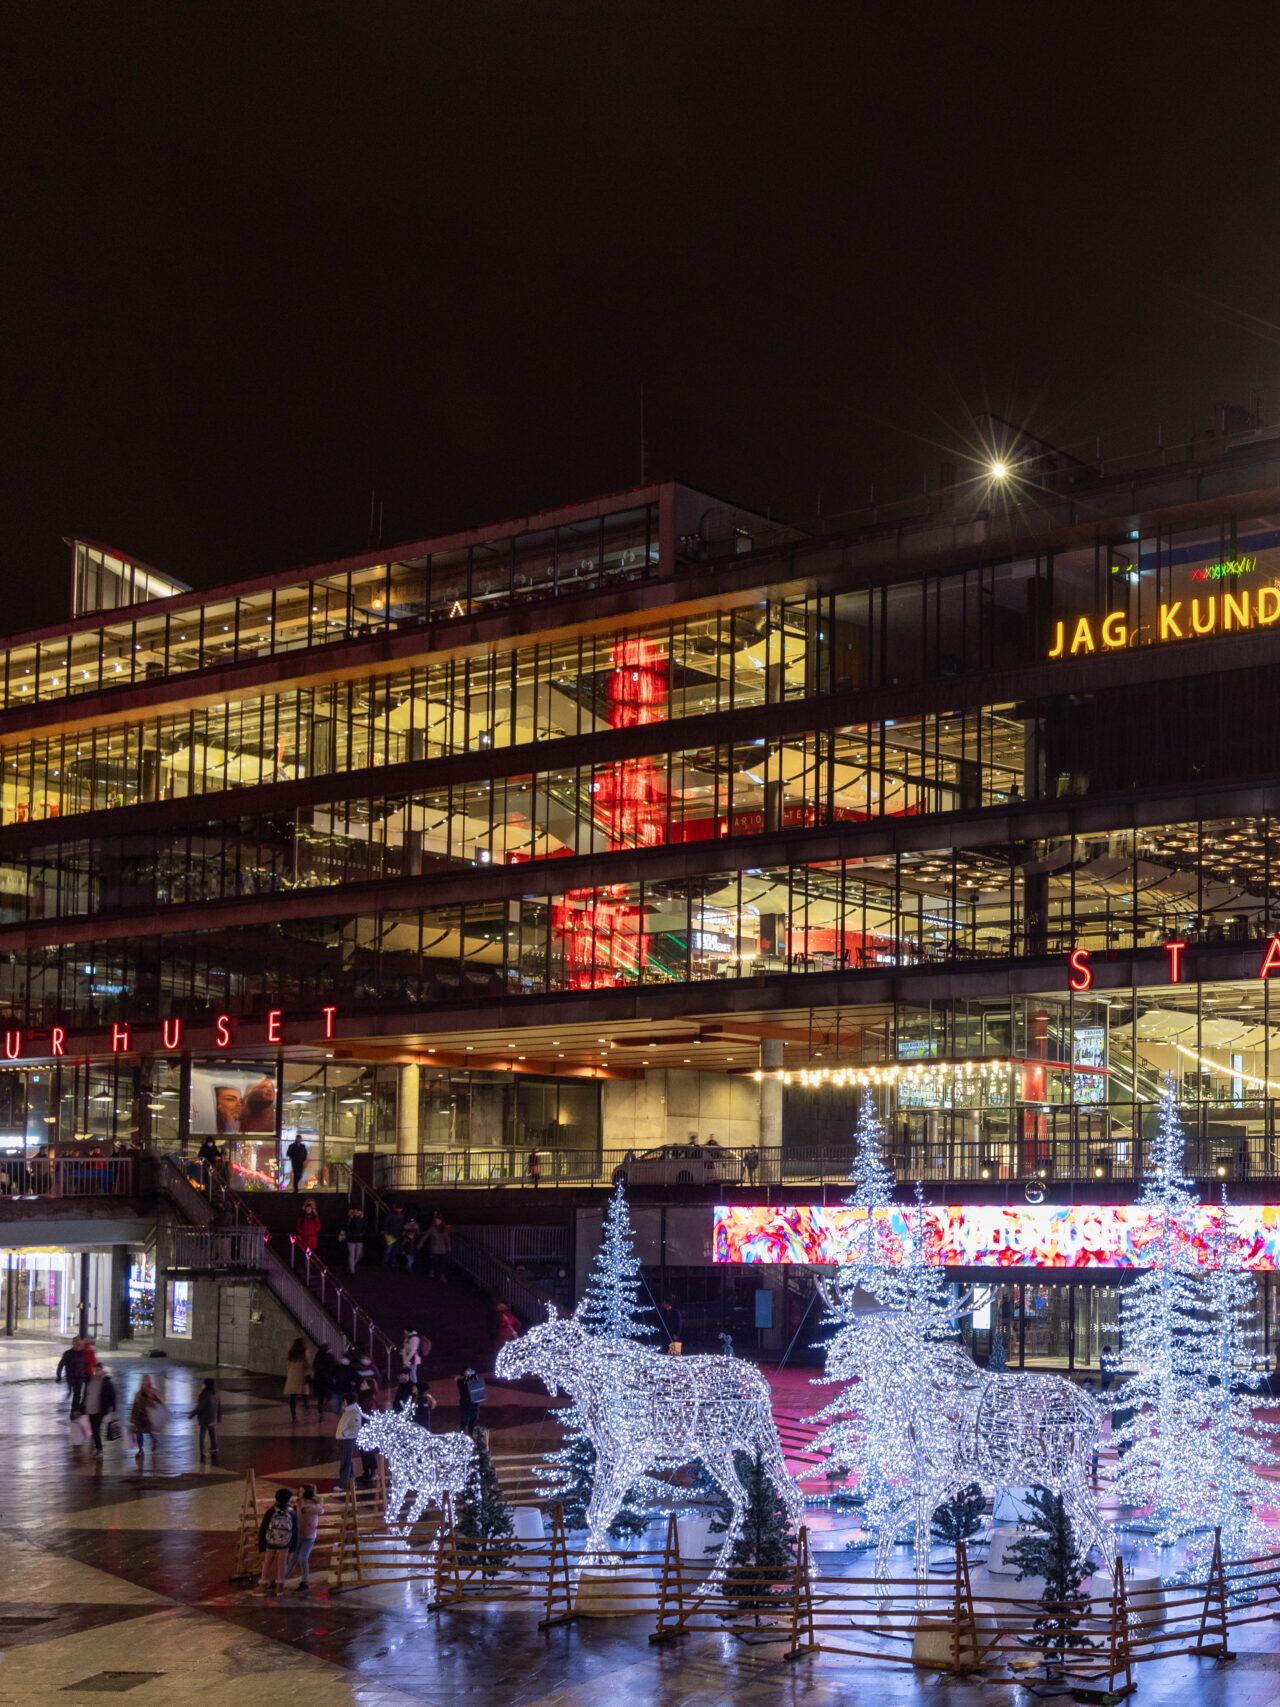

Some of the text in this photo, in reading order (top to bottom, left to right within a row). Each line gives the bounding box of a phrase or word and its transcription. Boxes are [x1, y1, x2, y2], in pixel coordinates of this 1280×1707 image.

[1048, 611, 1128, 657] JAG
[5, 1007, 336, 1059] URHUSET
[952, 1222, 1128, 1251] KULTURHUSET
